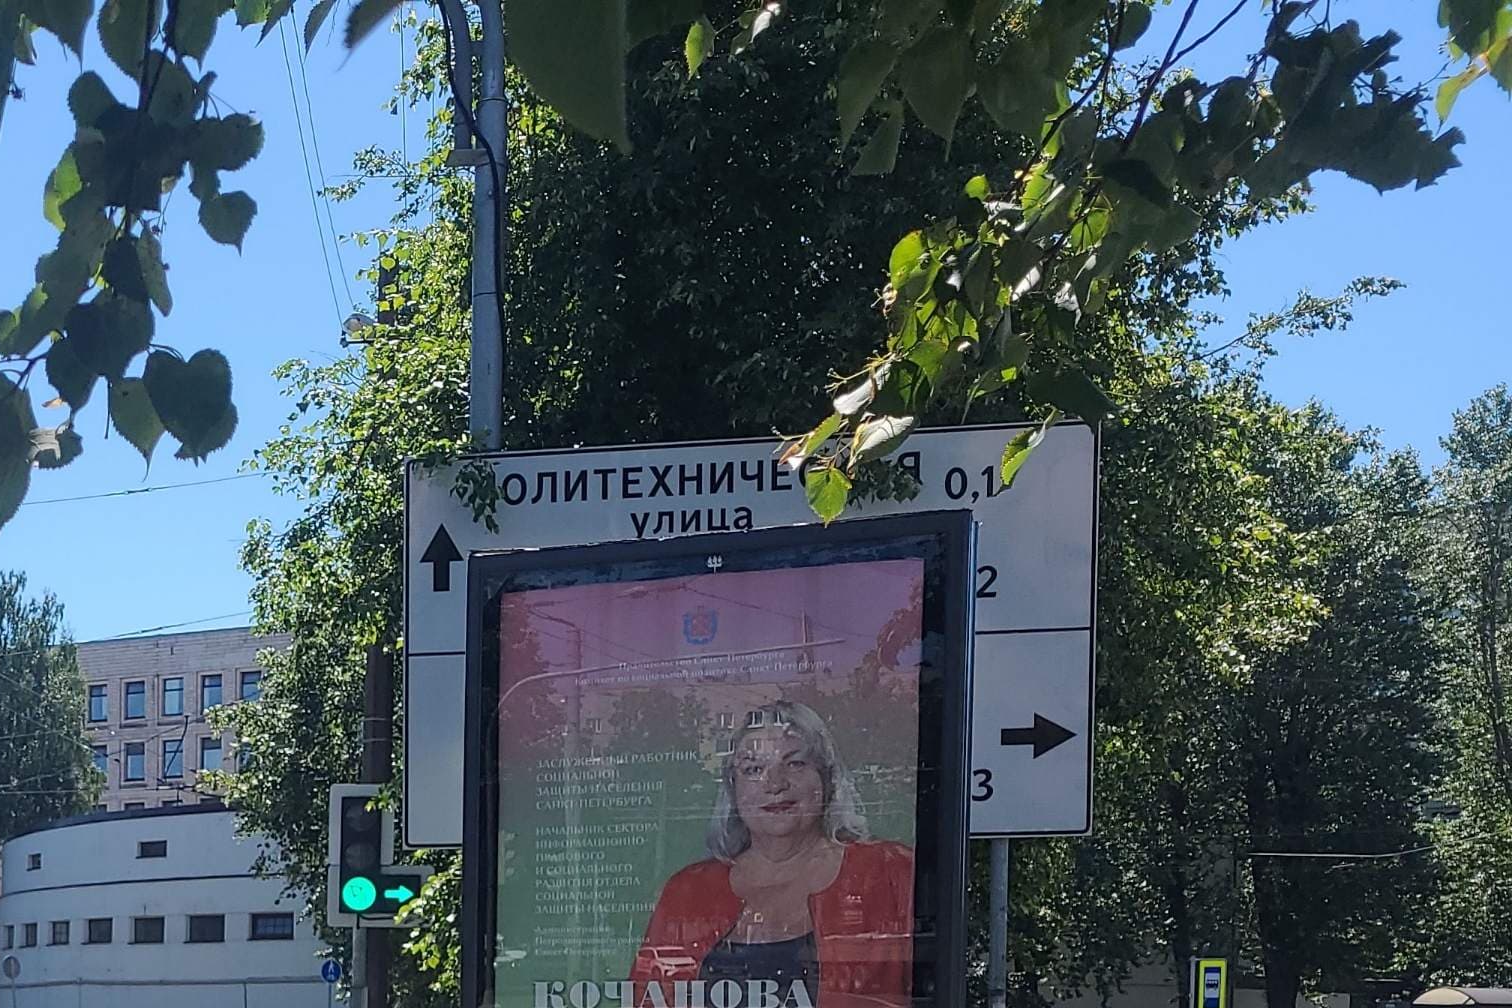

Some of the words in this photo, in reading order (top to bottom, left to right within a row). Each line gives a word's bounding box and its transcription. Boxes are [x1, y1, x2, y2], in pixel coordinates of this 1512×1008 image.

[944, 465, 995, 504] 0,1
[630, 505, 754, 538] улица
[976, 565, 998, 599] 2
[631, 750, 697, 763] РАБОТНИК
[971, 768, 994, 802] 3
[607, 822, 659, 834] СЕКТОРА
